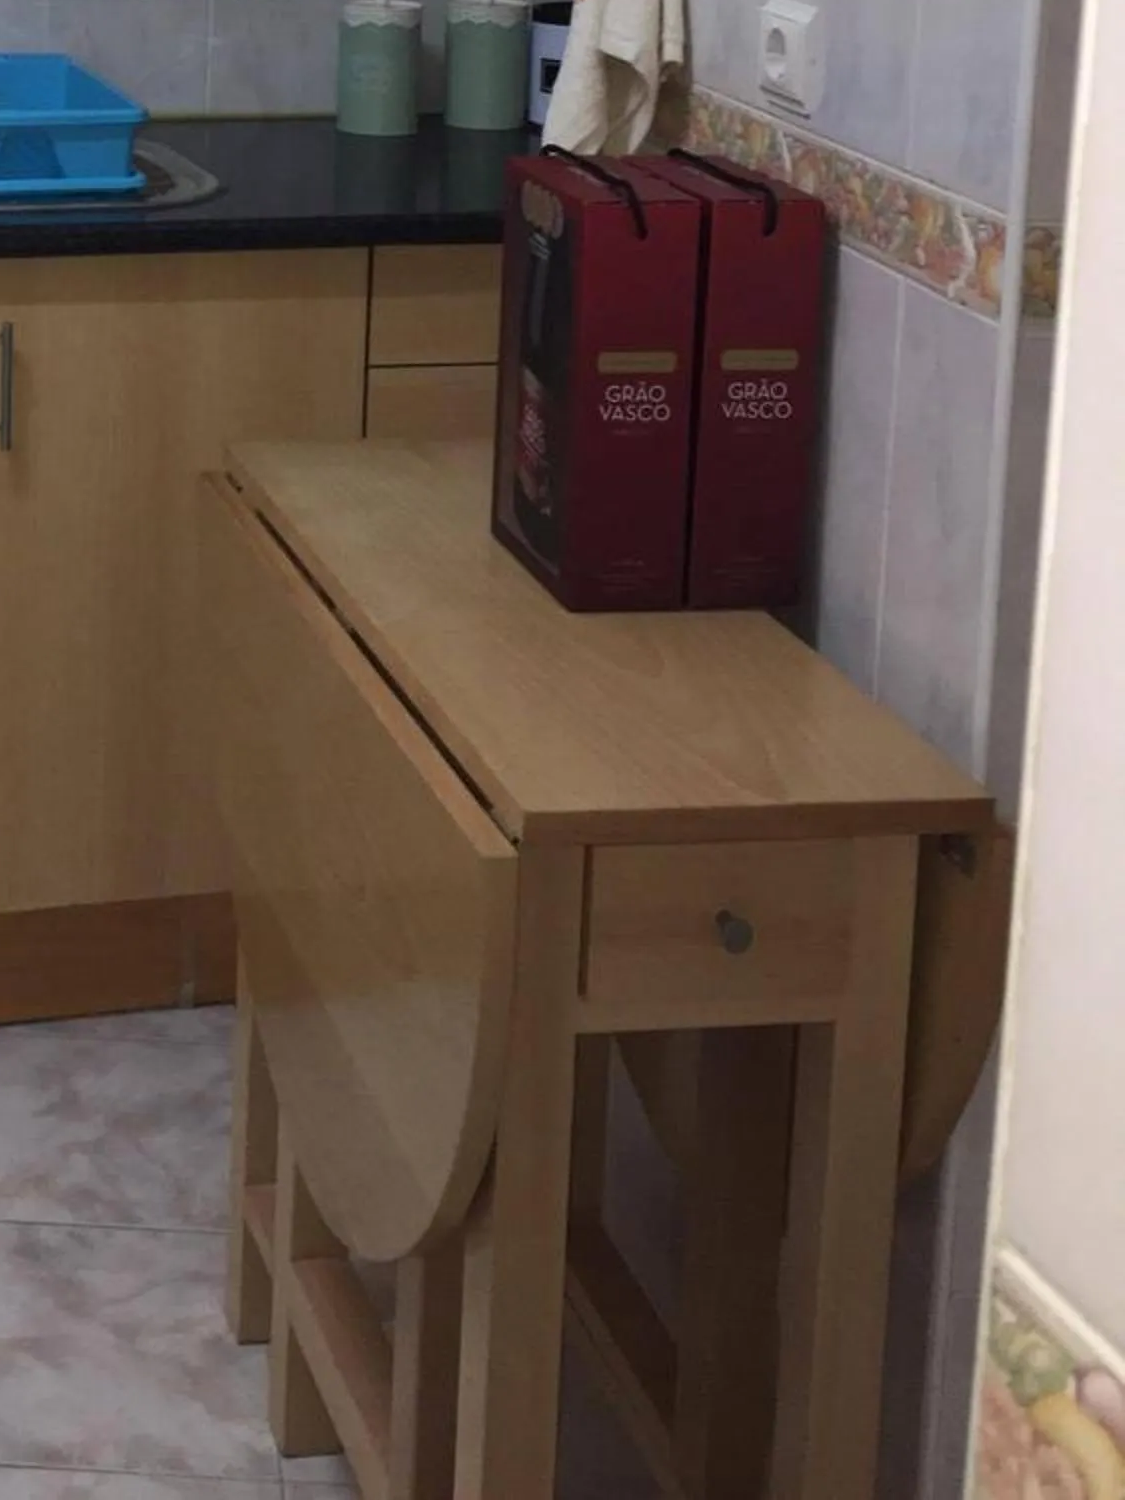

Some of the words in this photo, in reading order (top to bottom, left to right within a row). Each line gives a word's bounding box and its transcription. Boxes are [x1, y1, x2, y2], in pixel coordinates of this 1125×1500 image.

[605, 381, 665, 403] GRÃO
[728, 378, 787, 400] GRÃO
[600, 403, 670, 422] VASCO
[721, 401, 792, 419] VASCO
